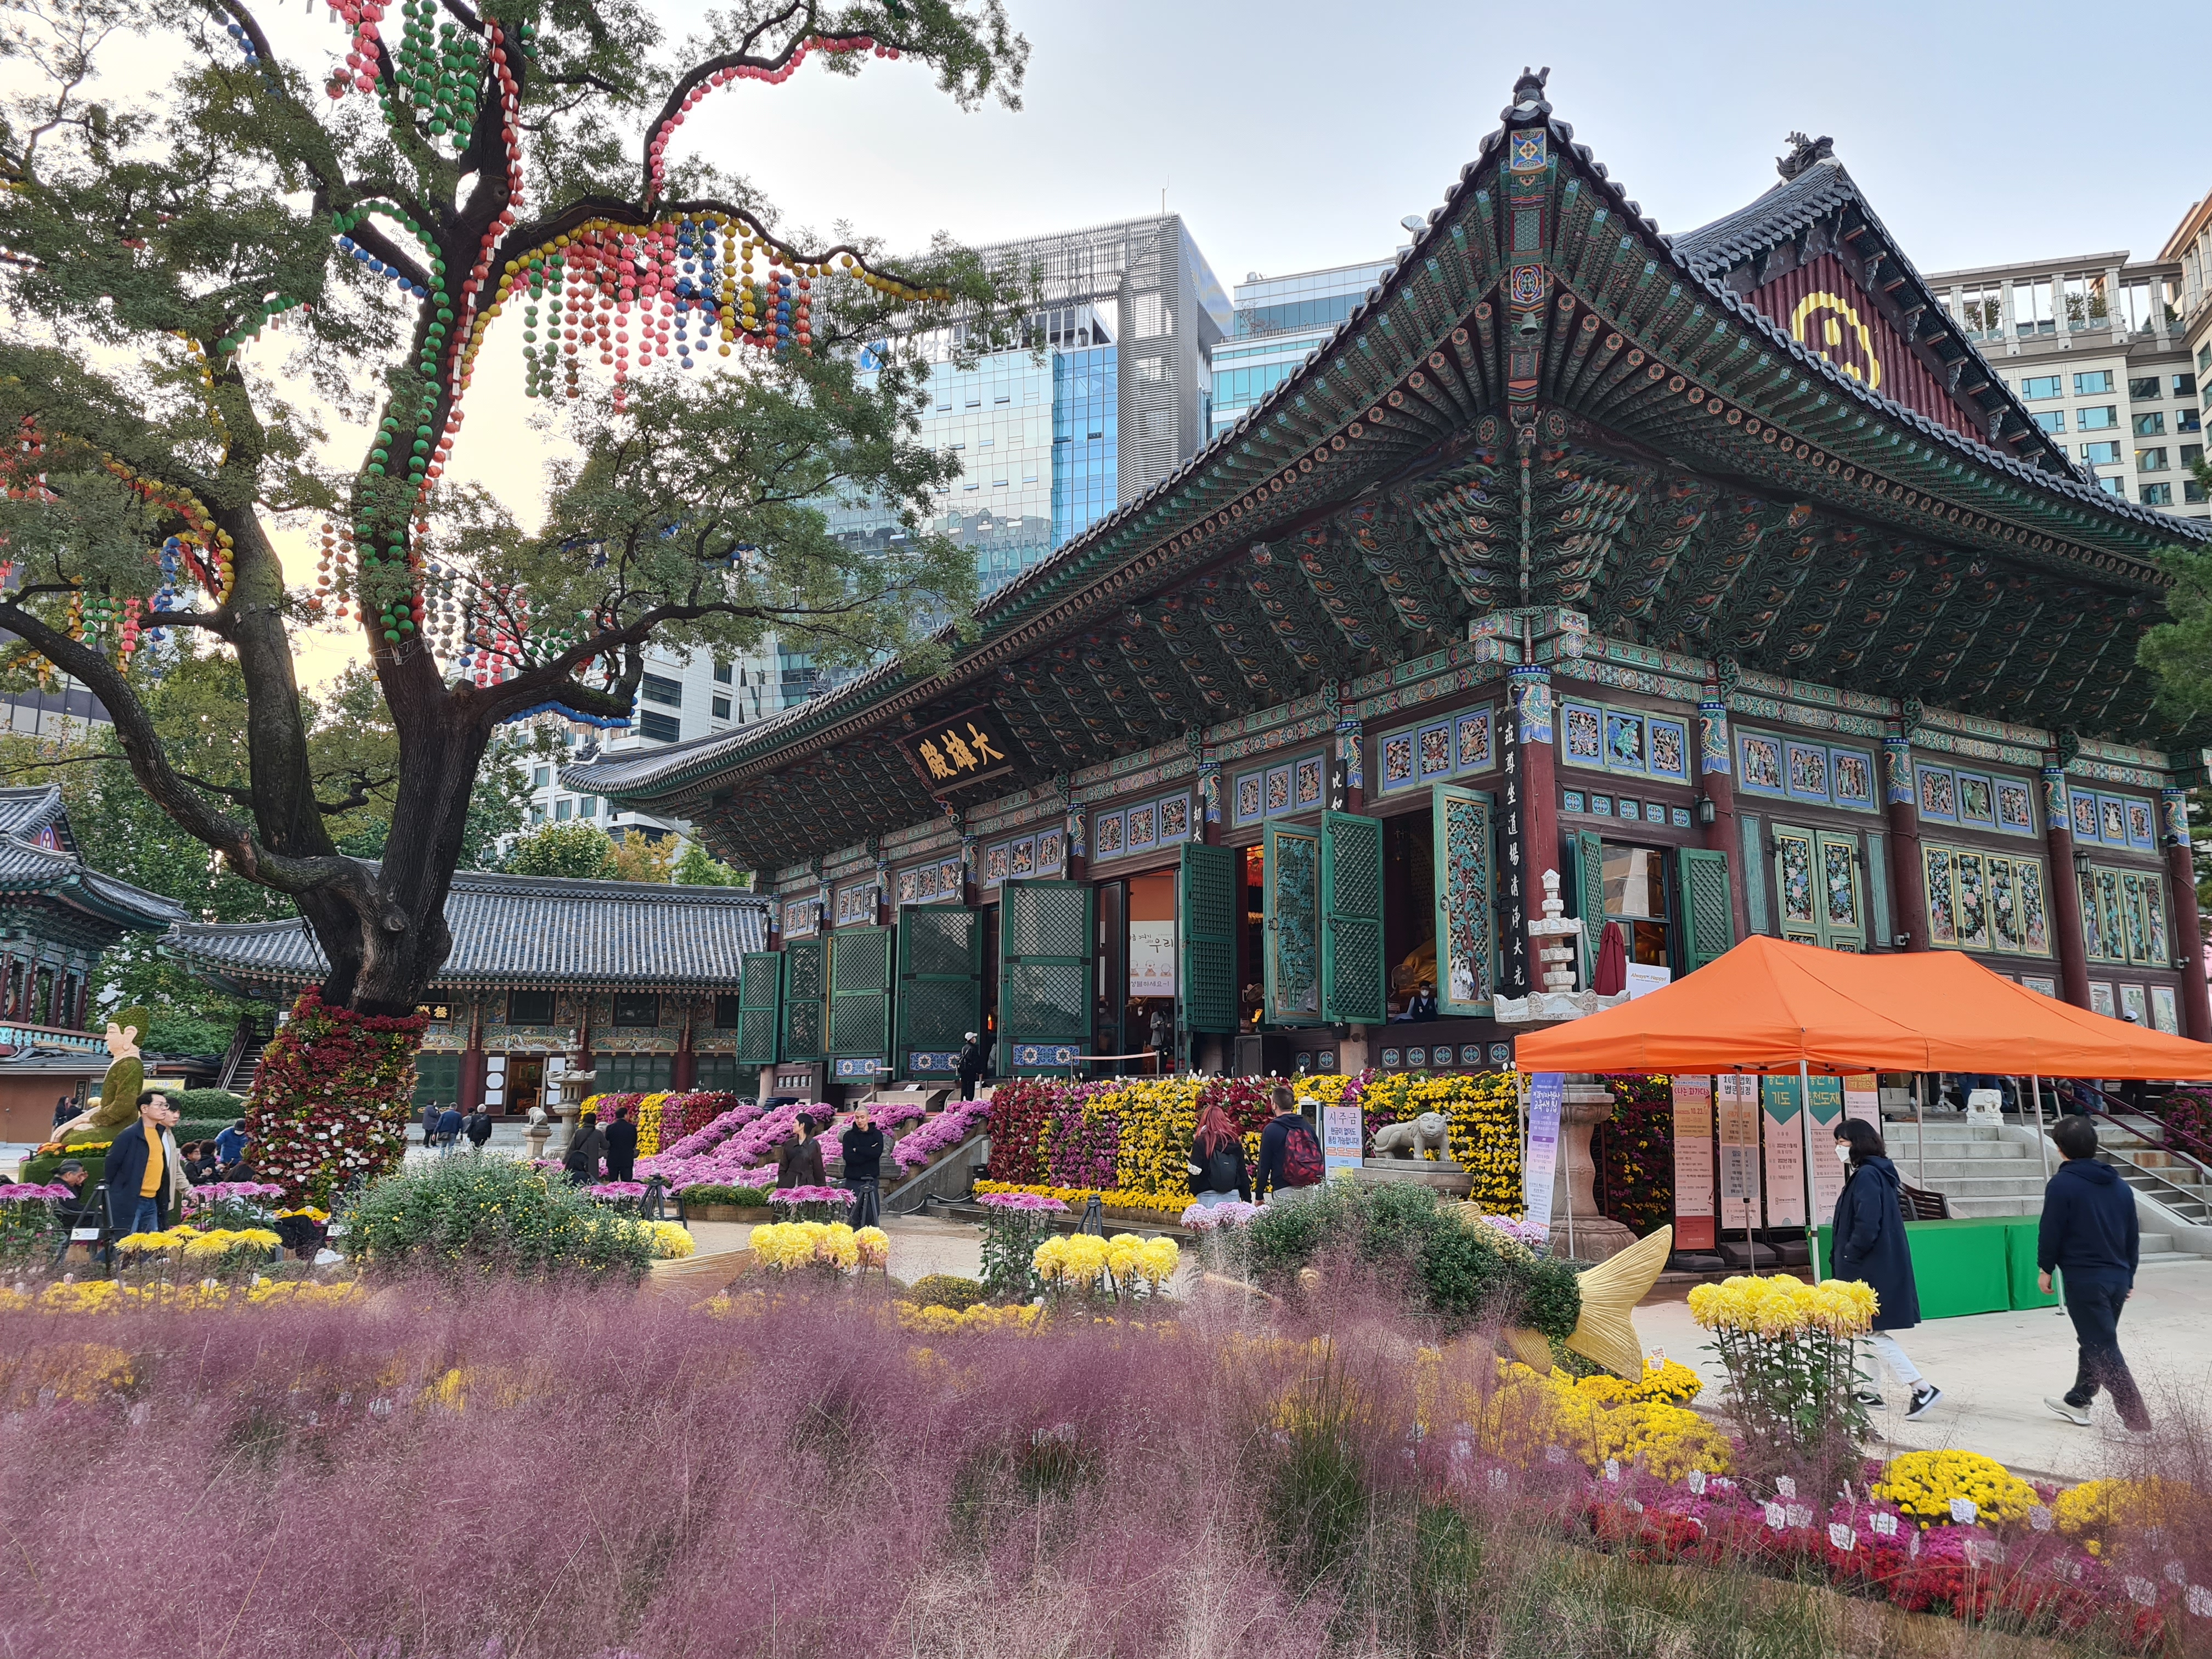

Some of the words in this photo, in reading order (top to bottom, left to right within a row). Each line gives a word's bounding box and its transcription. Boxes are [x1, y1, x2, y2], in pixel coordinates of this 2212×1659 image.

[1149, 938, 1173, 953] 우리
[1771, 1091, 1791, 1105] 기도
[1330, 1127, 1343, 1136] 현금이
[1344, 1127, 1357, 1136] 없어도
[1328, 1136, 1337, 1144] 동참
